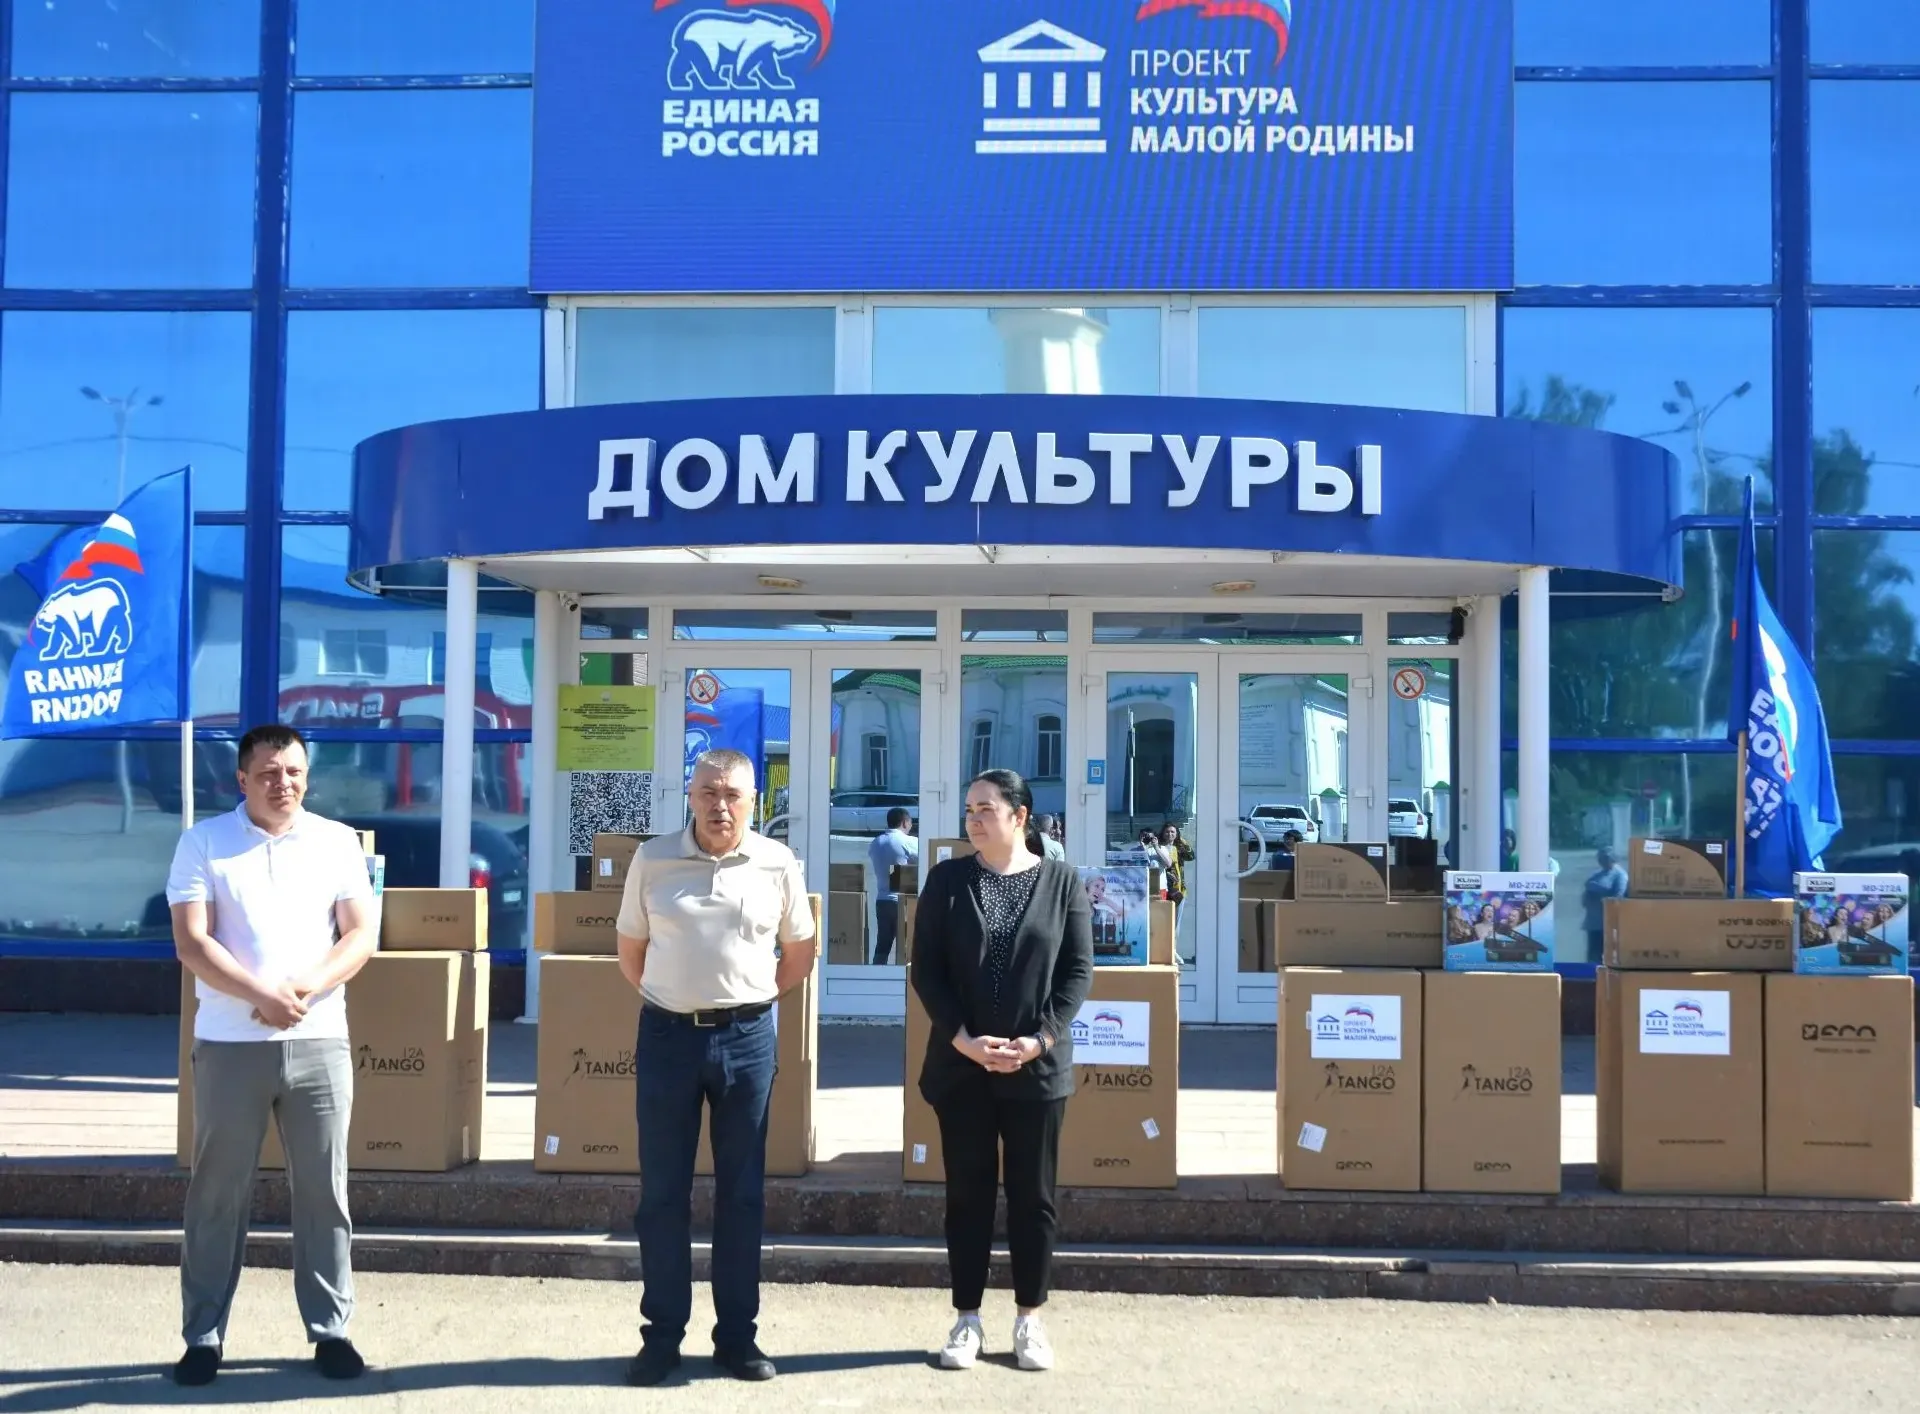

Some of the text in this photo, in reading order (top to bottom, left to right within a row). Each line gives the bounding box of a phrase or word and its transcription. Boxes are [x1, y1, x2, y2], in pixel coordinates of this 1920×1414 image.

[1131, 49, 1251, 77] ПРОЕКТ
[1131, 87, 1298, 116] КУЛЬТУРА
[663, 98, 819, 128] ЕДИНАЯ
[662, 130, 819, 157] РОССИЯ
[1130, 118, 1414, 156] МАЛОЙ РОДИНЫ
[588, 429, 1382, 520] ДОМ КУЛЬТУРЫ
[1093, 1039, 1145, 1048] МАЛОЙ РОДИНЫ
[404, 1047, 425, 1058] 12A
[370, 1058, 425, 1072] TANGO
[1372, 1064, 1395, 1077] 12A
[1509, 1066, 1532, 1078] 12A
[1095, 1073, 1153, 1087] TANGO
[1337, 1076, 1396, 1090] TANGO
[1474, 1077, 1533, 1092] TANGO
